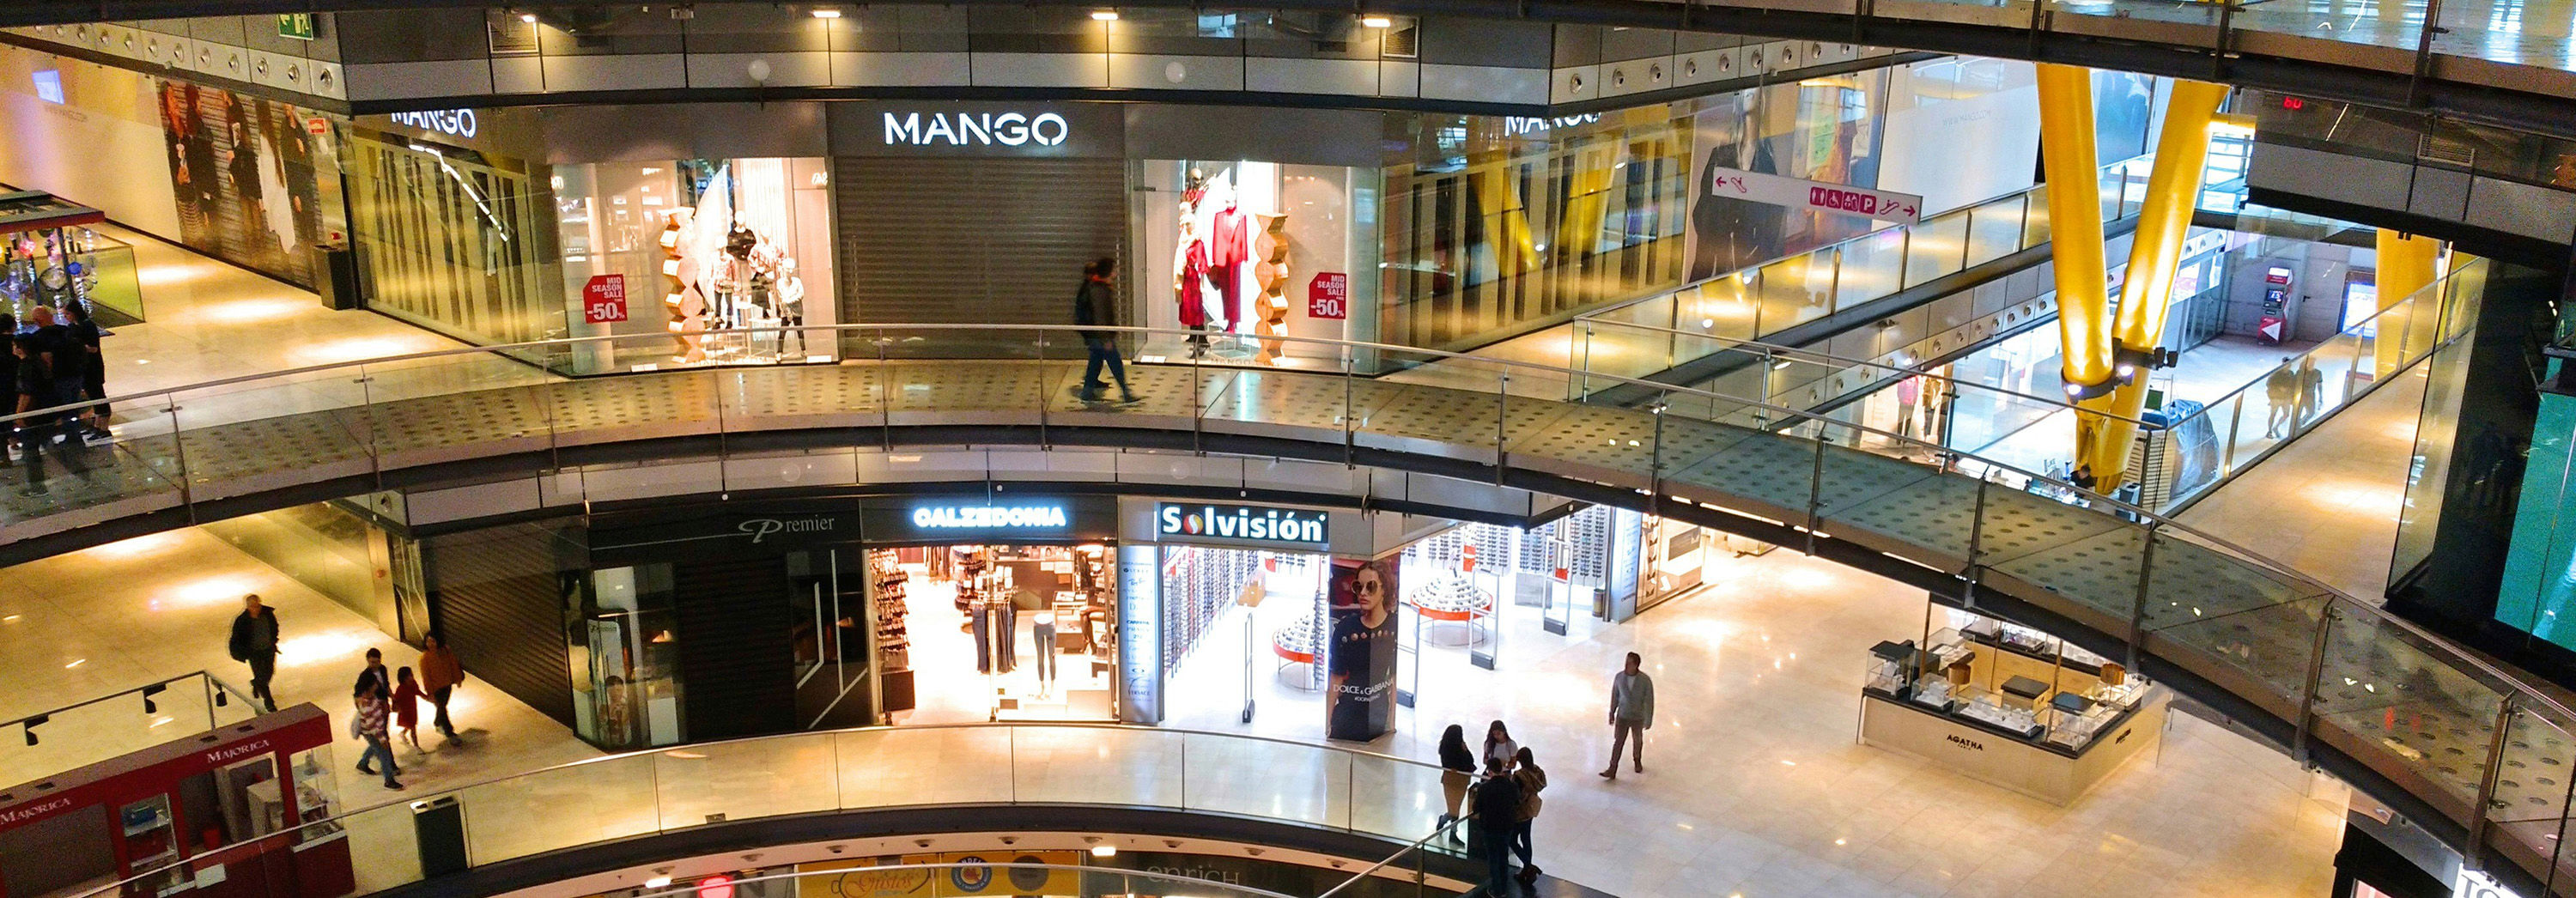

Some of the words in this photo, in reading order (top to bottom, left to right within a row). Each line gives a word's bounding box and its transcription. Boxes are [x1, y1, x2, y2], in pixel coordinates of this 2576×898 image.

[884, 112, 1069, 146] MANGO
[1863, 197, 1874, 211] P
[592, 283, 623, 293] SEASON
[606, 276, 622, 285] MID
[1316, 280, 1346, 289] SEASON
[586, 301, 626, 321] -50%
[1310, 298, 1346, 318] -50%
[913, 506, 1067, 528] CALZEDONIA
[738, 513, 835, 543] Premier
[1333, 683, 1360, 695] DOLCE
[206, 738, 270, 763] MAJORICA
[1946, 734, 1984, 751] AGATHA
[0, 797, 71, 825] MAJORICA
